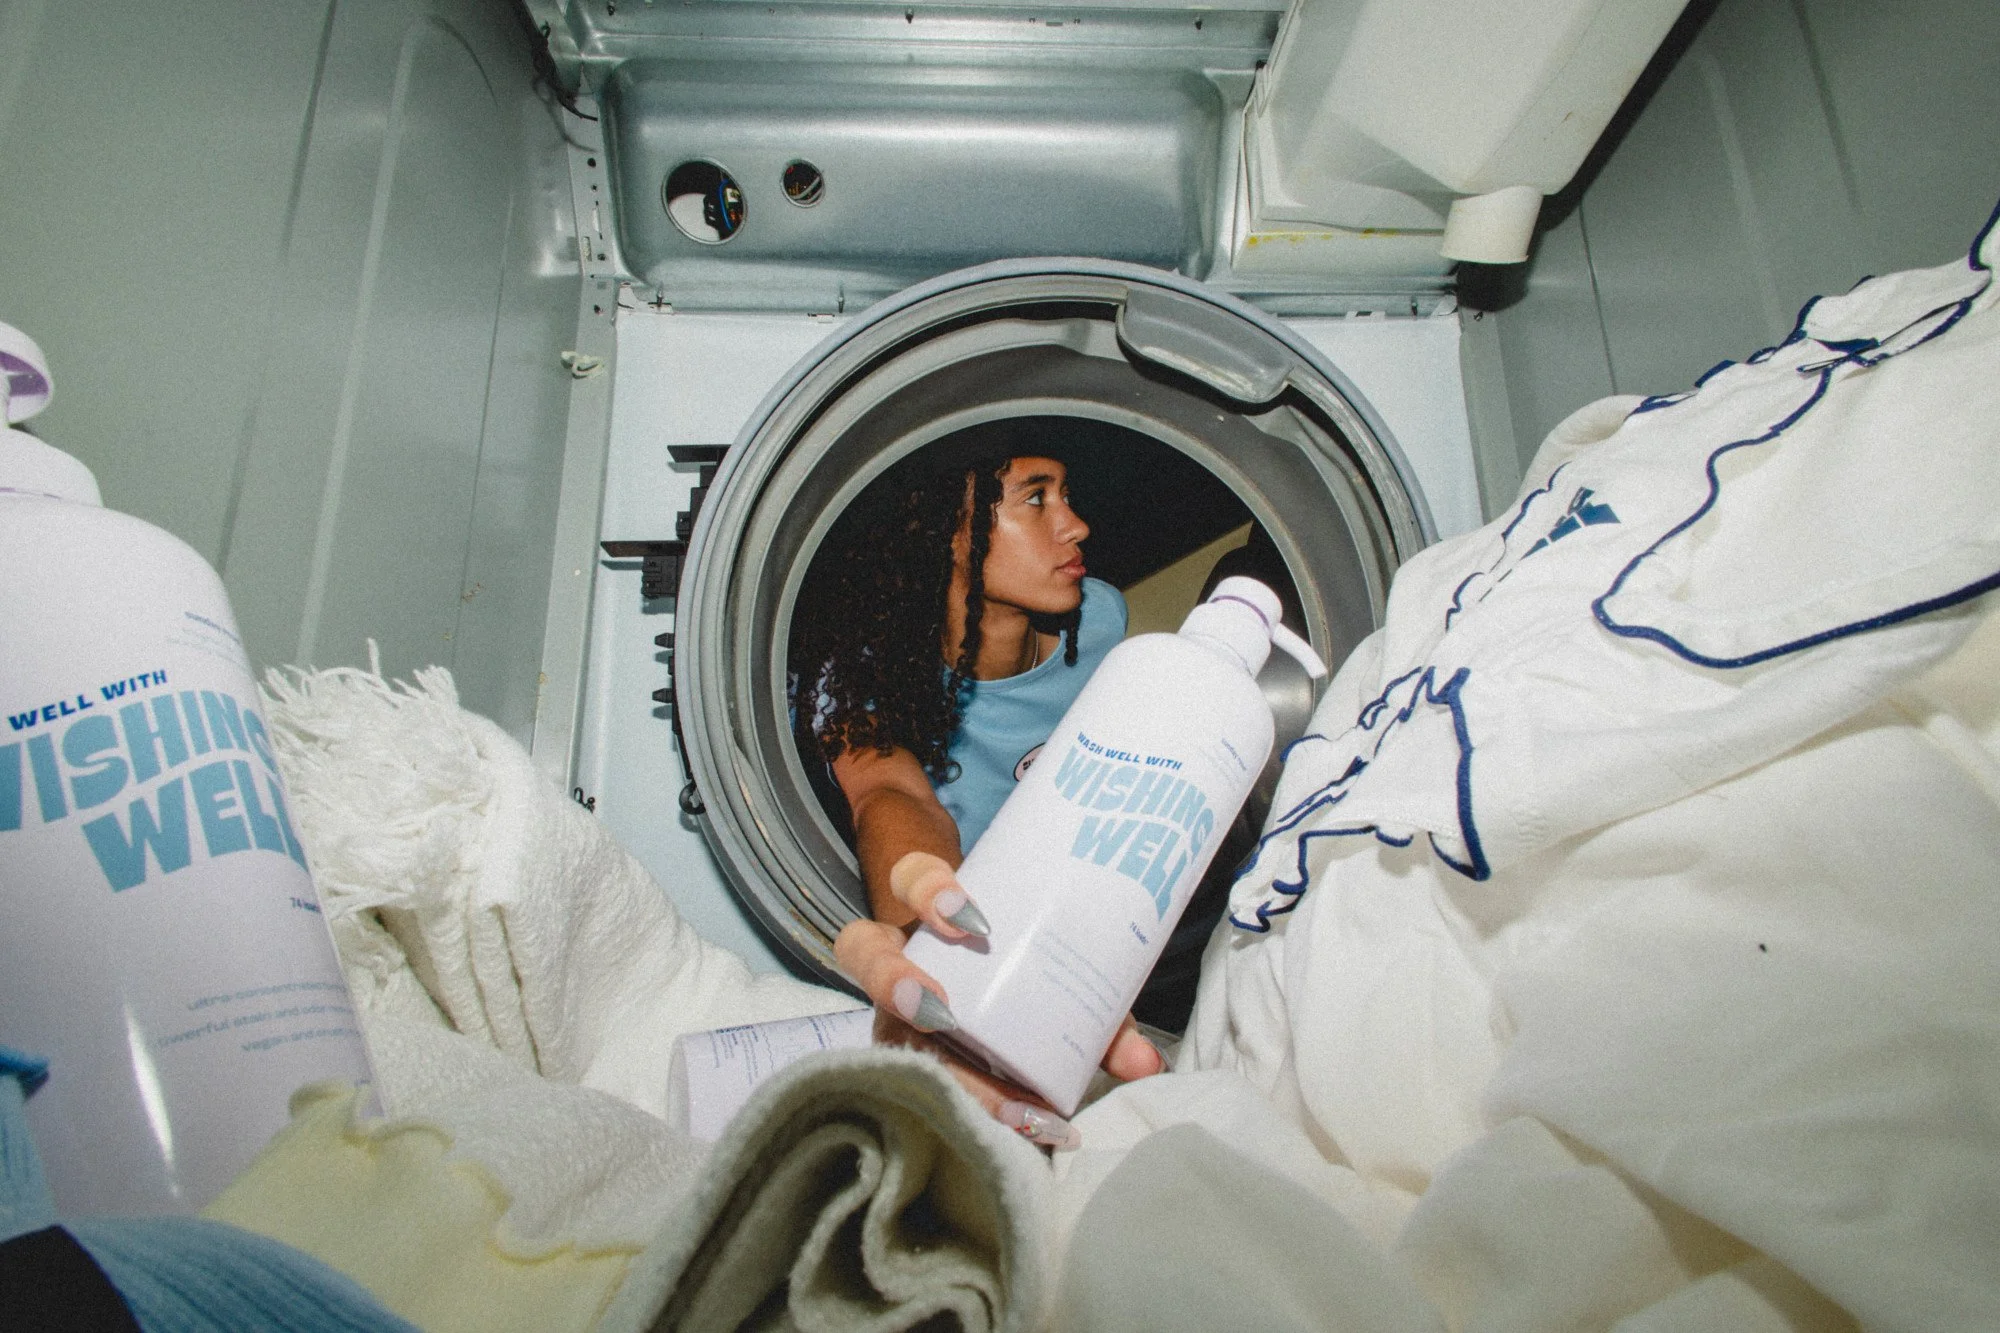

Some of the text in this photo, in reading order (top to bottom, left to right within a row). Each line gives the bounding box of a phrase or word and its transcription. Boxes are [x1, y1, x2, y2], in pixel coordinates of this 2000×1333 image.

[8, 669, 168, 731] WELL WITH
[1077, 731, 1182, 770] WASH WELL WITH
[82, 759, 309, 893] WELL
[1055, 745, 1214, 865] WISHING
[1071, 815, 1187, 922] WELL
